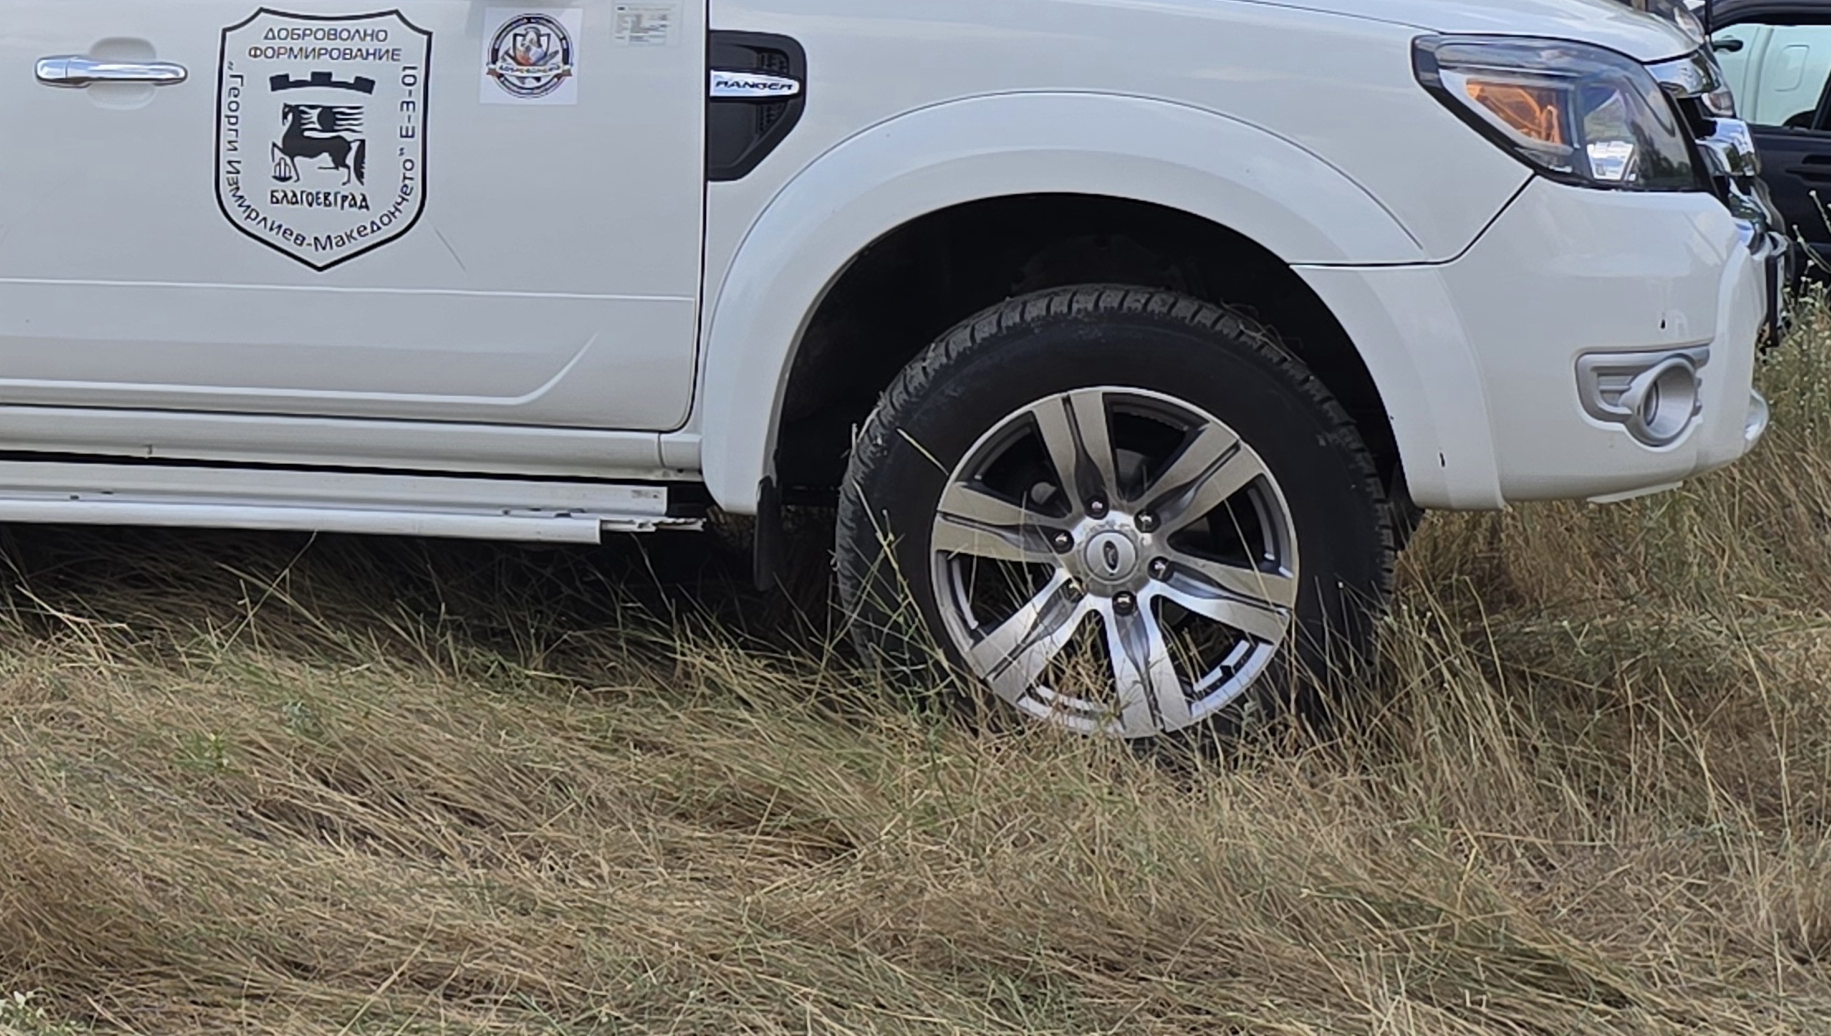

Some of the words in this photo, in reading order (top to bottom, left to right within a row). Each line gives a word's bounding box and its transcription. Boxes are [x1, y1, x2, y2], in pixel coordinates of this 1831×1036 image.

[262, 27, 389, 43] ДОБРОВОЛНО
[247, 45, 403, 63] ФОРМИРОВАНИЕ
[714, 79, 794, 91] RANGER
[269, 189, 371, 212] БЛАГОЕВГРАД
